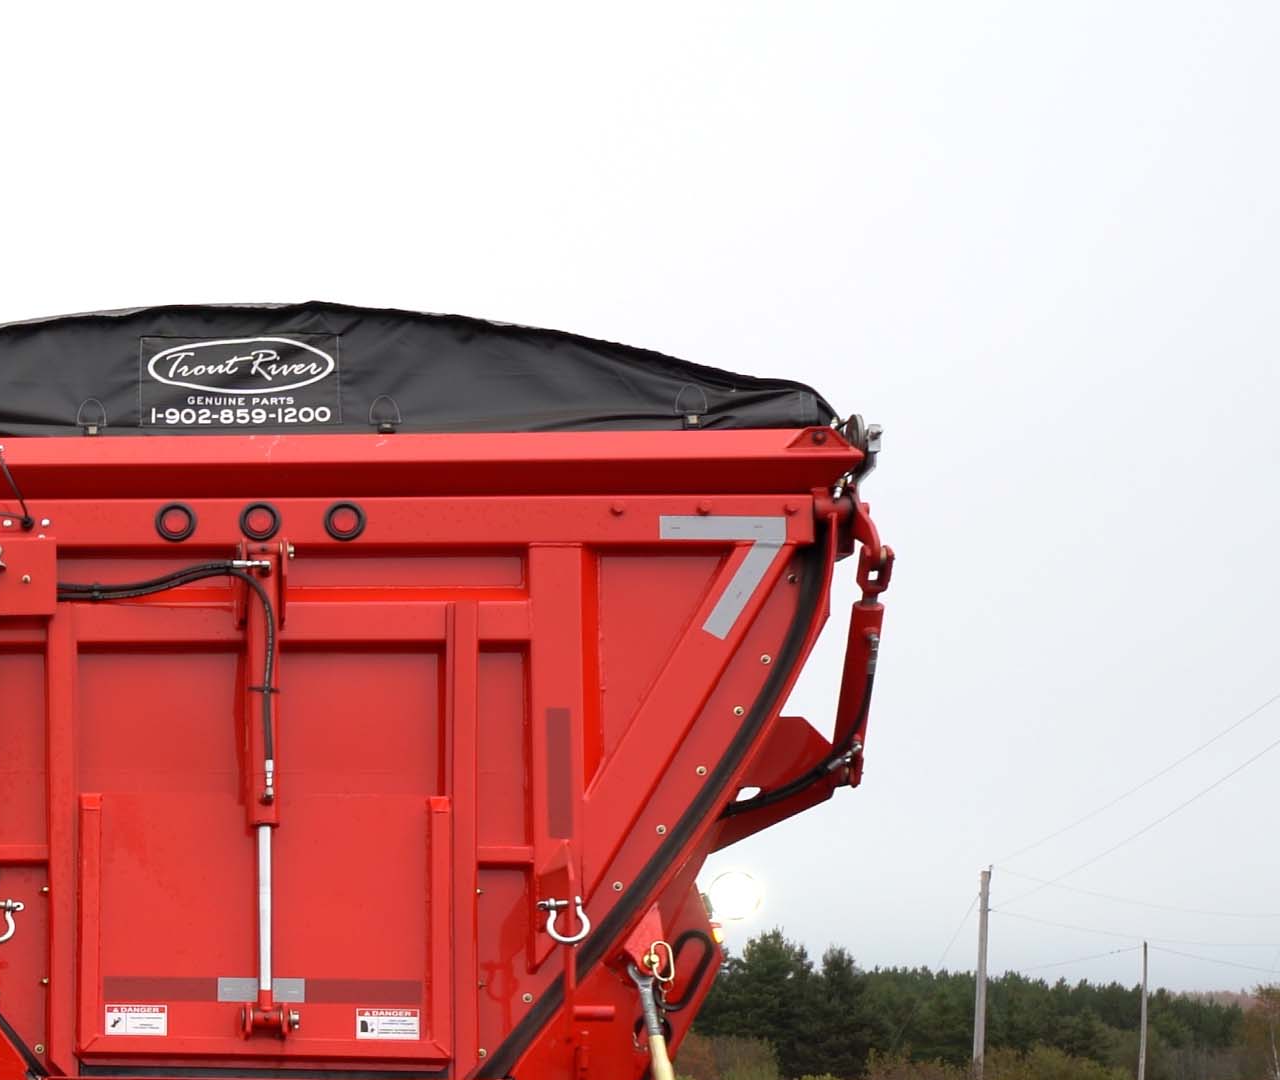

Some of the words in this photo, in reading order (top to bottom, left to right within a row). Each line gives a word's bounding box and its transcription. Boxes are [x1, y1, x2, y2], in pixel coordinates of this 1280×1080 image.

[166, 351, 240, 378] Trout
[250, 349, 322, 381] River
[187, 396, 245, 406] GENUINE
[252, 396, 295, 405] PARTS
[151, 407, 331, 424] 1-902-859-1200
